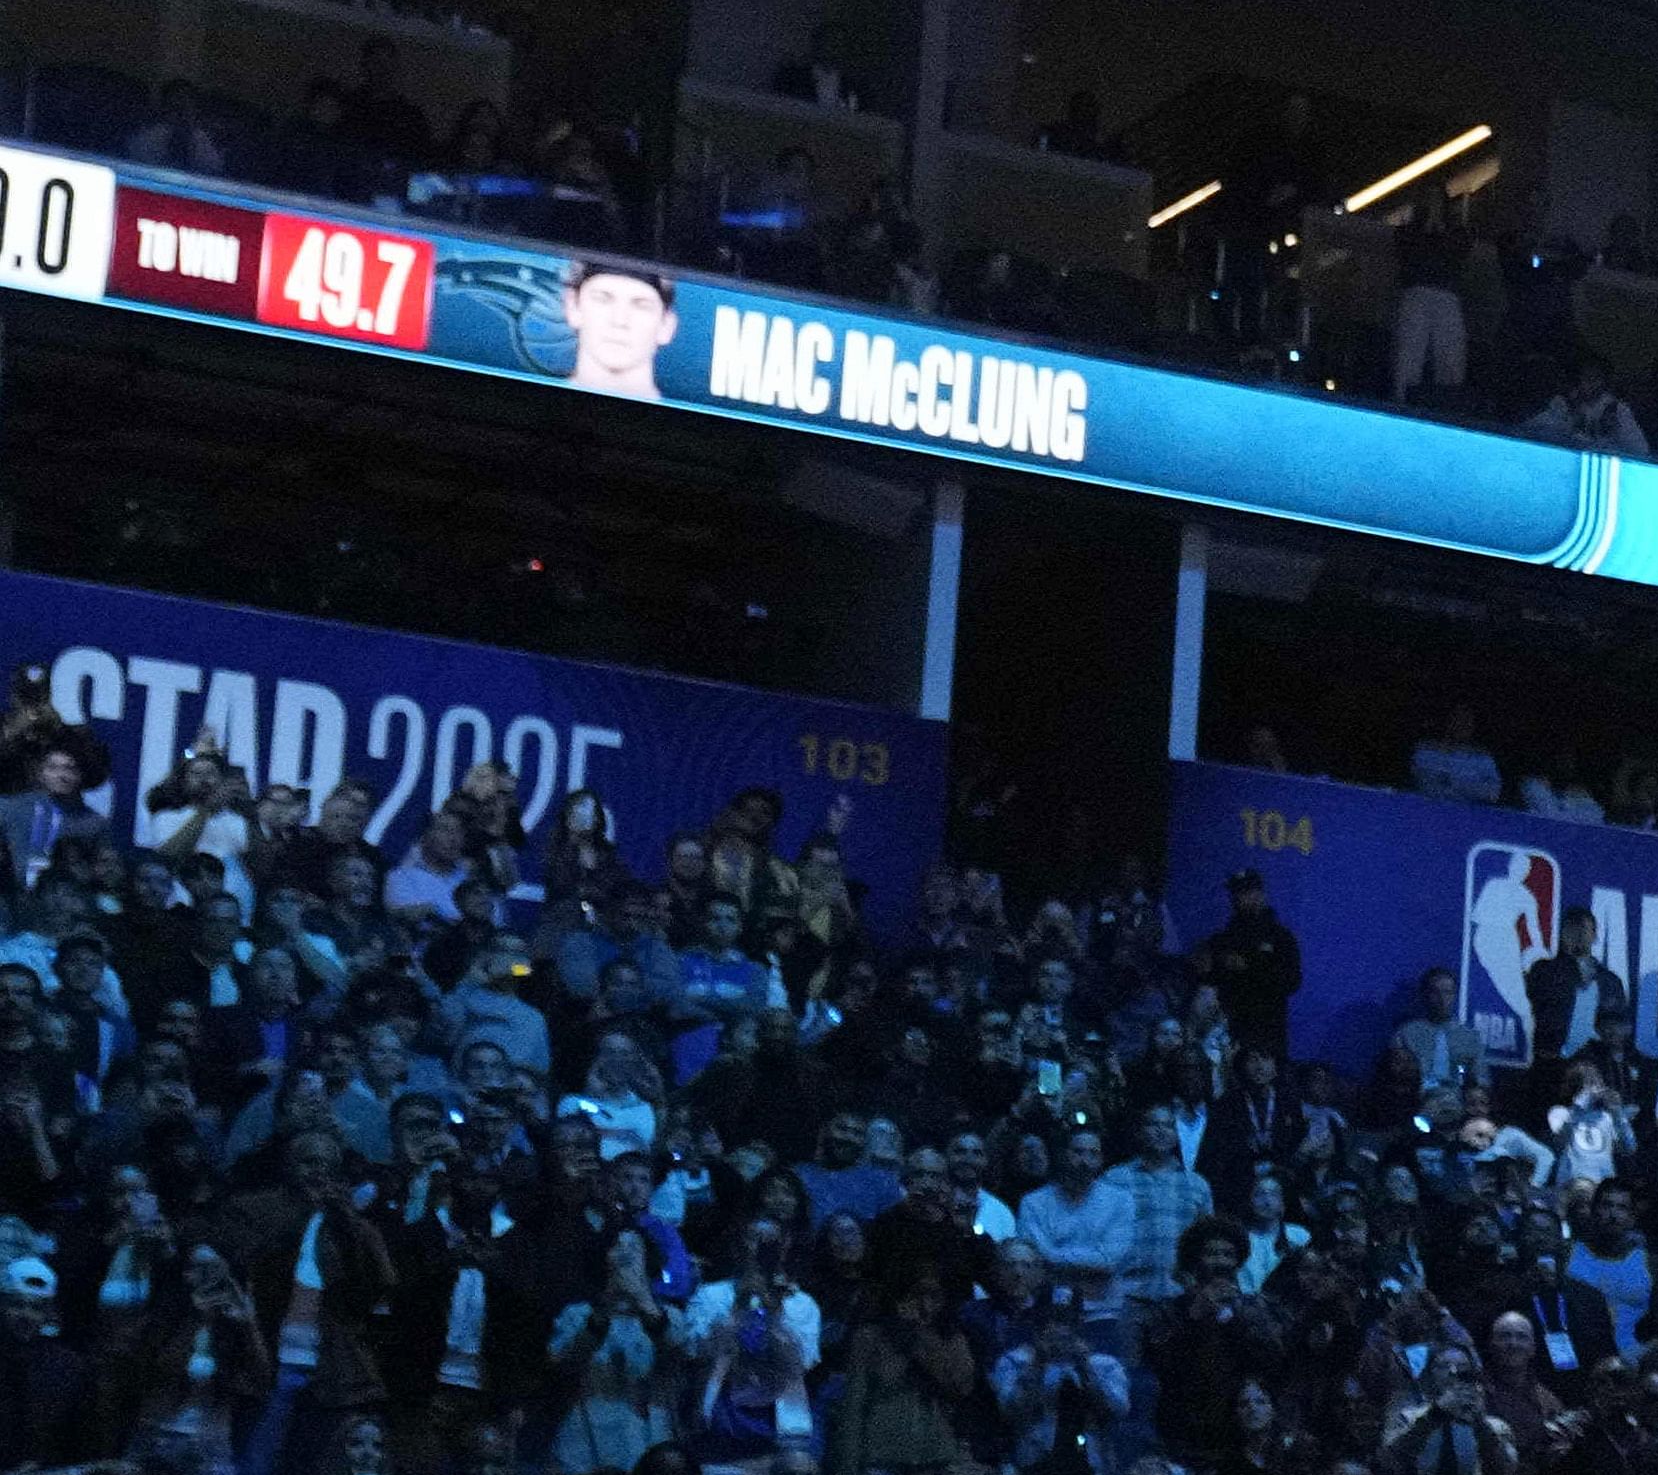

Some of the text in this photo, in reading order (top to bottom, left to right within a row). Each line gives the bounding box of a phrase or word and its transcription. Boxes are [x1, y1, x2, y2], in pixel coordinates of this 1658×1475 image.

[284, 226, 416, 337] 49.7
[709, 305, 1087, 463] MAC McCLUNG
[801, 732, 893, 788] 103
[1238, 806, 1314, 856] 104
